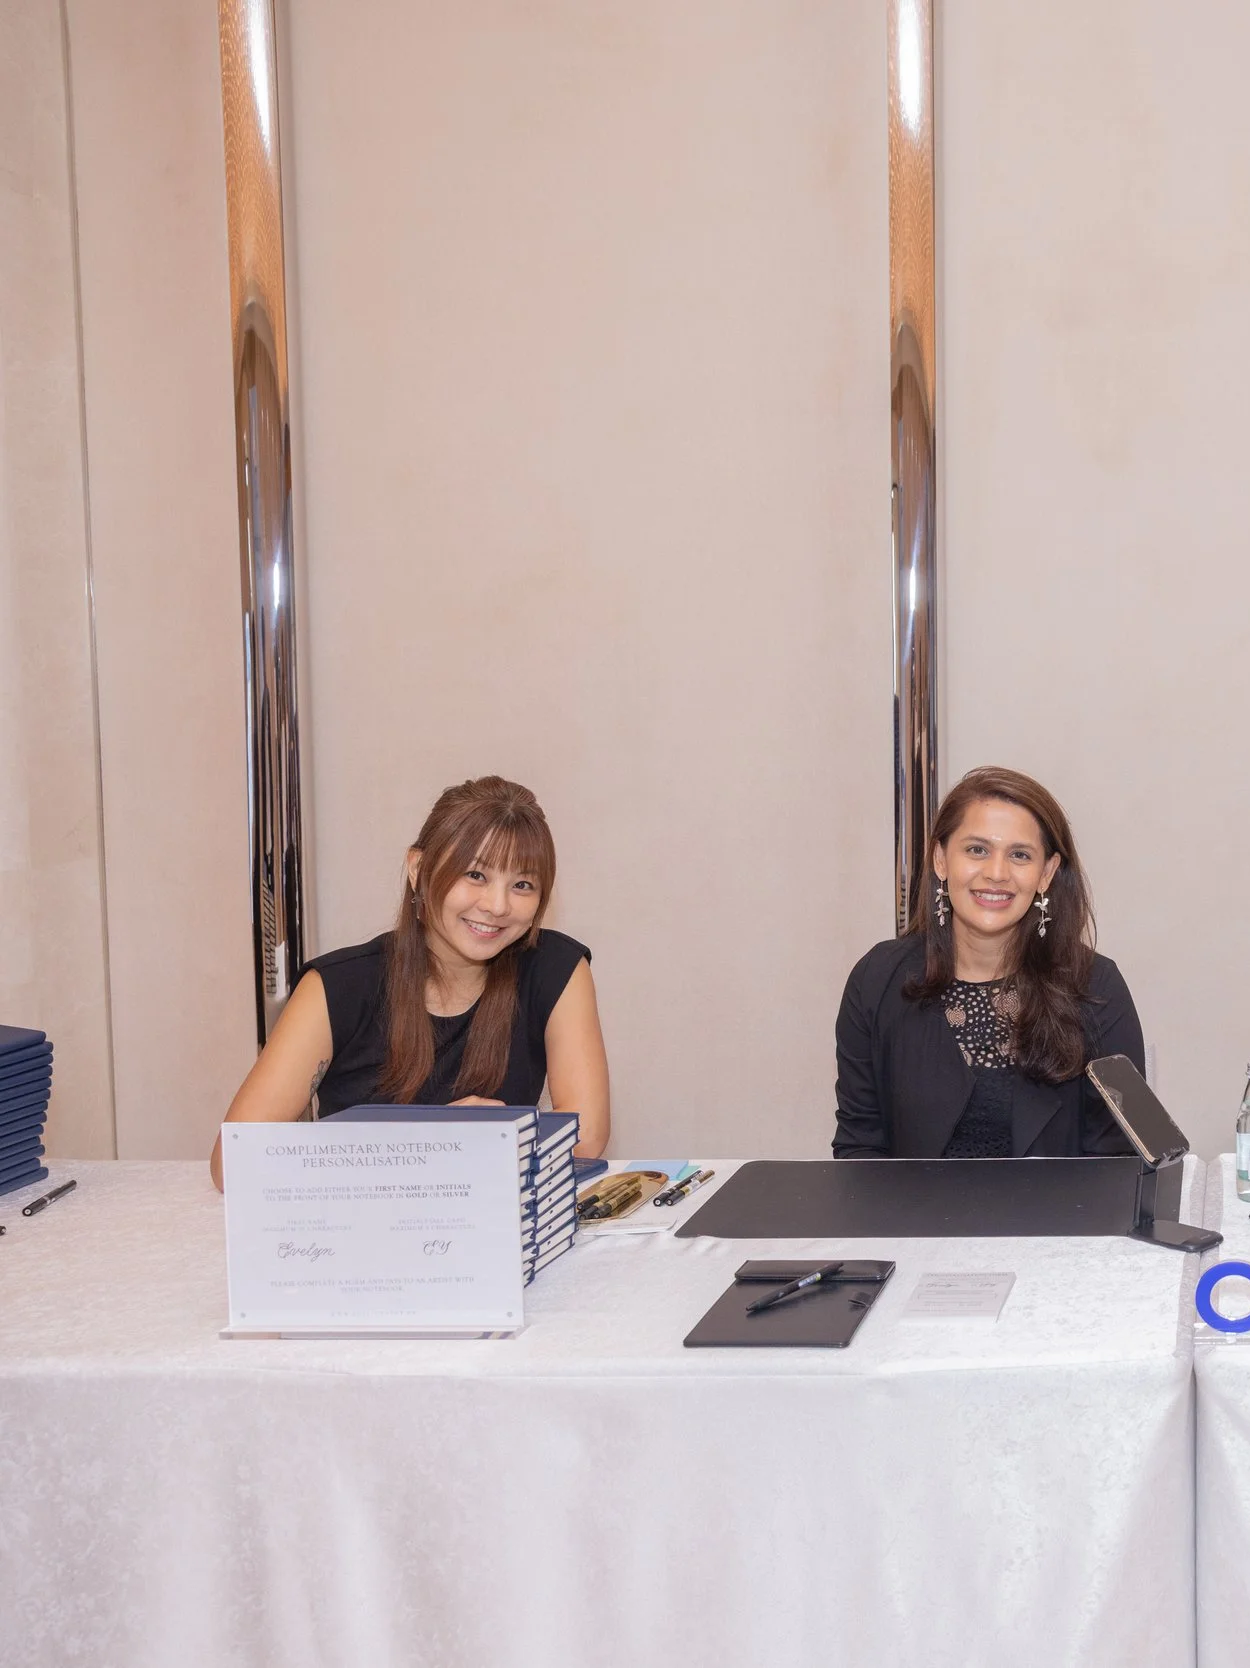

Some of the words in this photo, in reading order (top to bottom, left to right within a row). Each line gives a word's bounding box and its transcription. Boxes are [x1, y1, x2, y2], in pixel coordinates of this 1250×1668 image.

[265, 1143, 382, 1156] COMPLIMENTARY
[387, 1141, 463, 1153] NOTEBOOK
[302, 1155, 428, 1168] PERSONALISATION
[436, 1183, 472, 1191] INITIALS
[353, 1192, 394, 1200] NOTEBOOK
[277, 1241, 336, 1262] Evelyn
